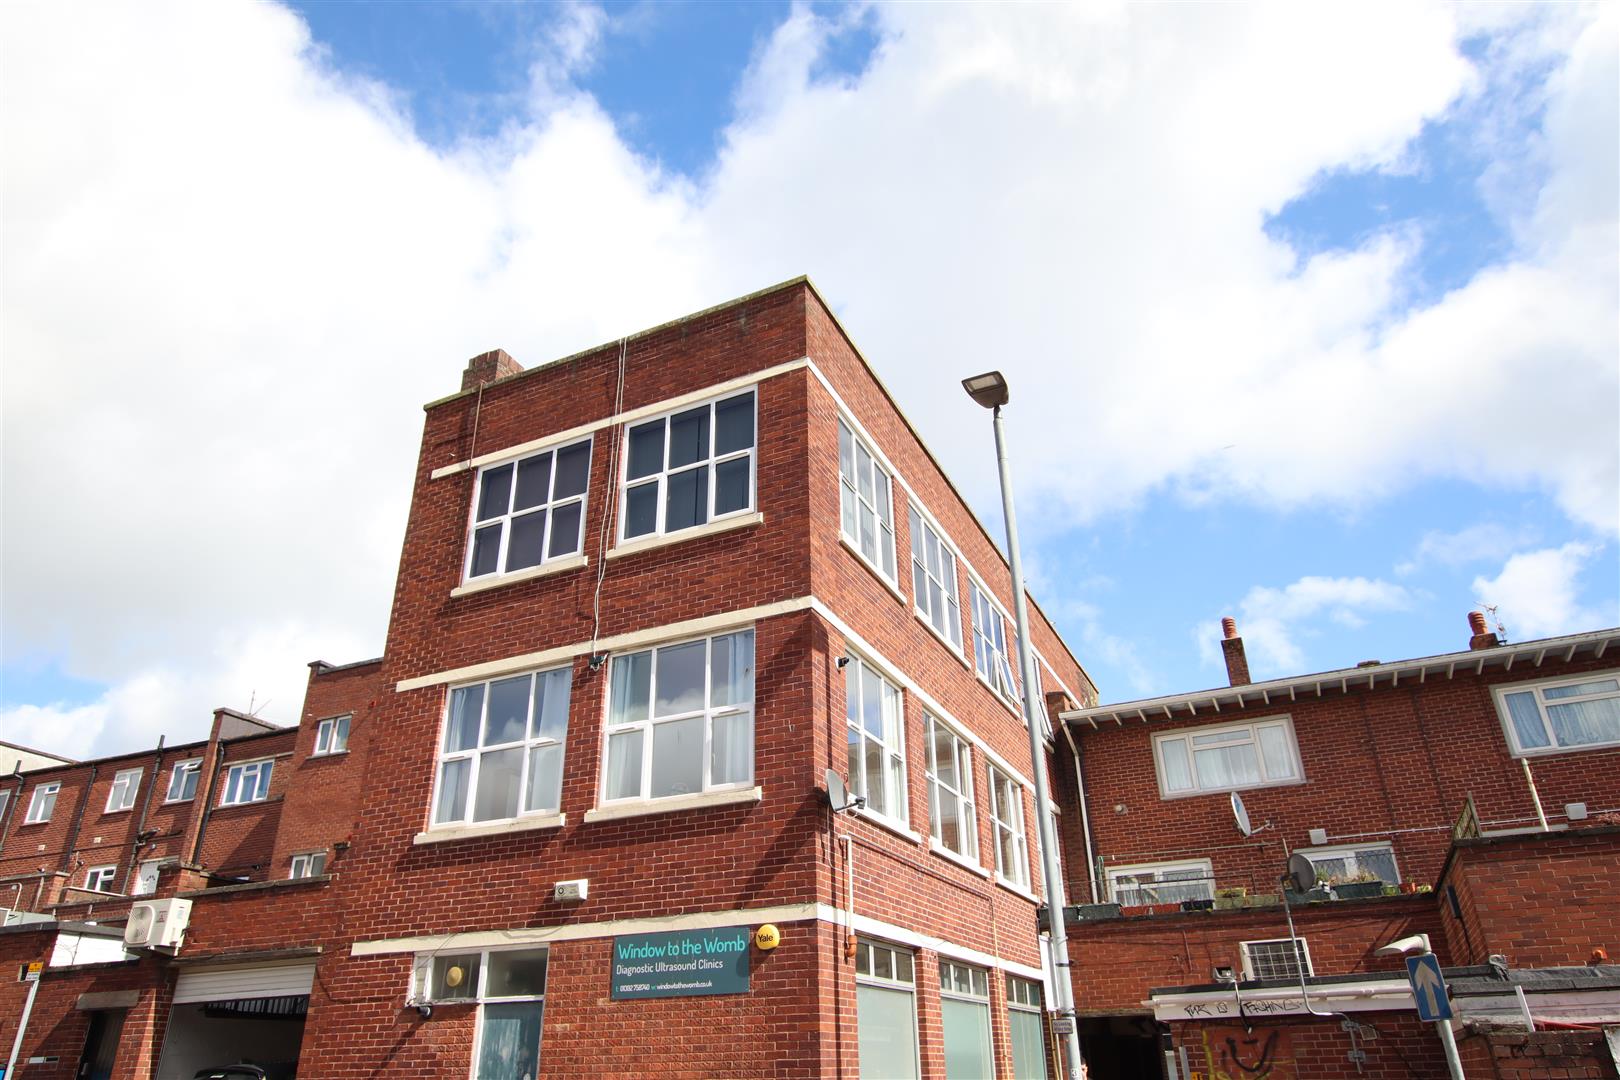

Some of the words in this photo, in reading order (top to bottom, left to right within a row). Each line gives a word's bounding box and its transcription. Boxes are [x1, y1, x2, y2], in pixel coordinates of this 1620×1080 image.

[617, 941, 666, 960] Window
[667, 941, 679, 956] to
[681, 938, 702, 956] the
[703, 934, 746, 953] Womb
[757, 934, 774, 943] Yale
[616, 963, 654, 977] Diagnostic
[655, 960, 697, 973] Ultrasound
[698, 959, 724, 970] Clinics
